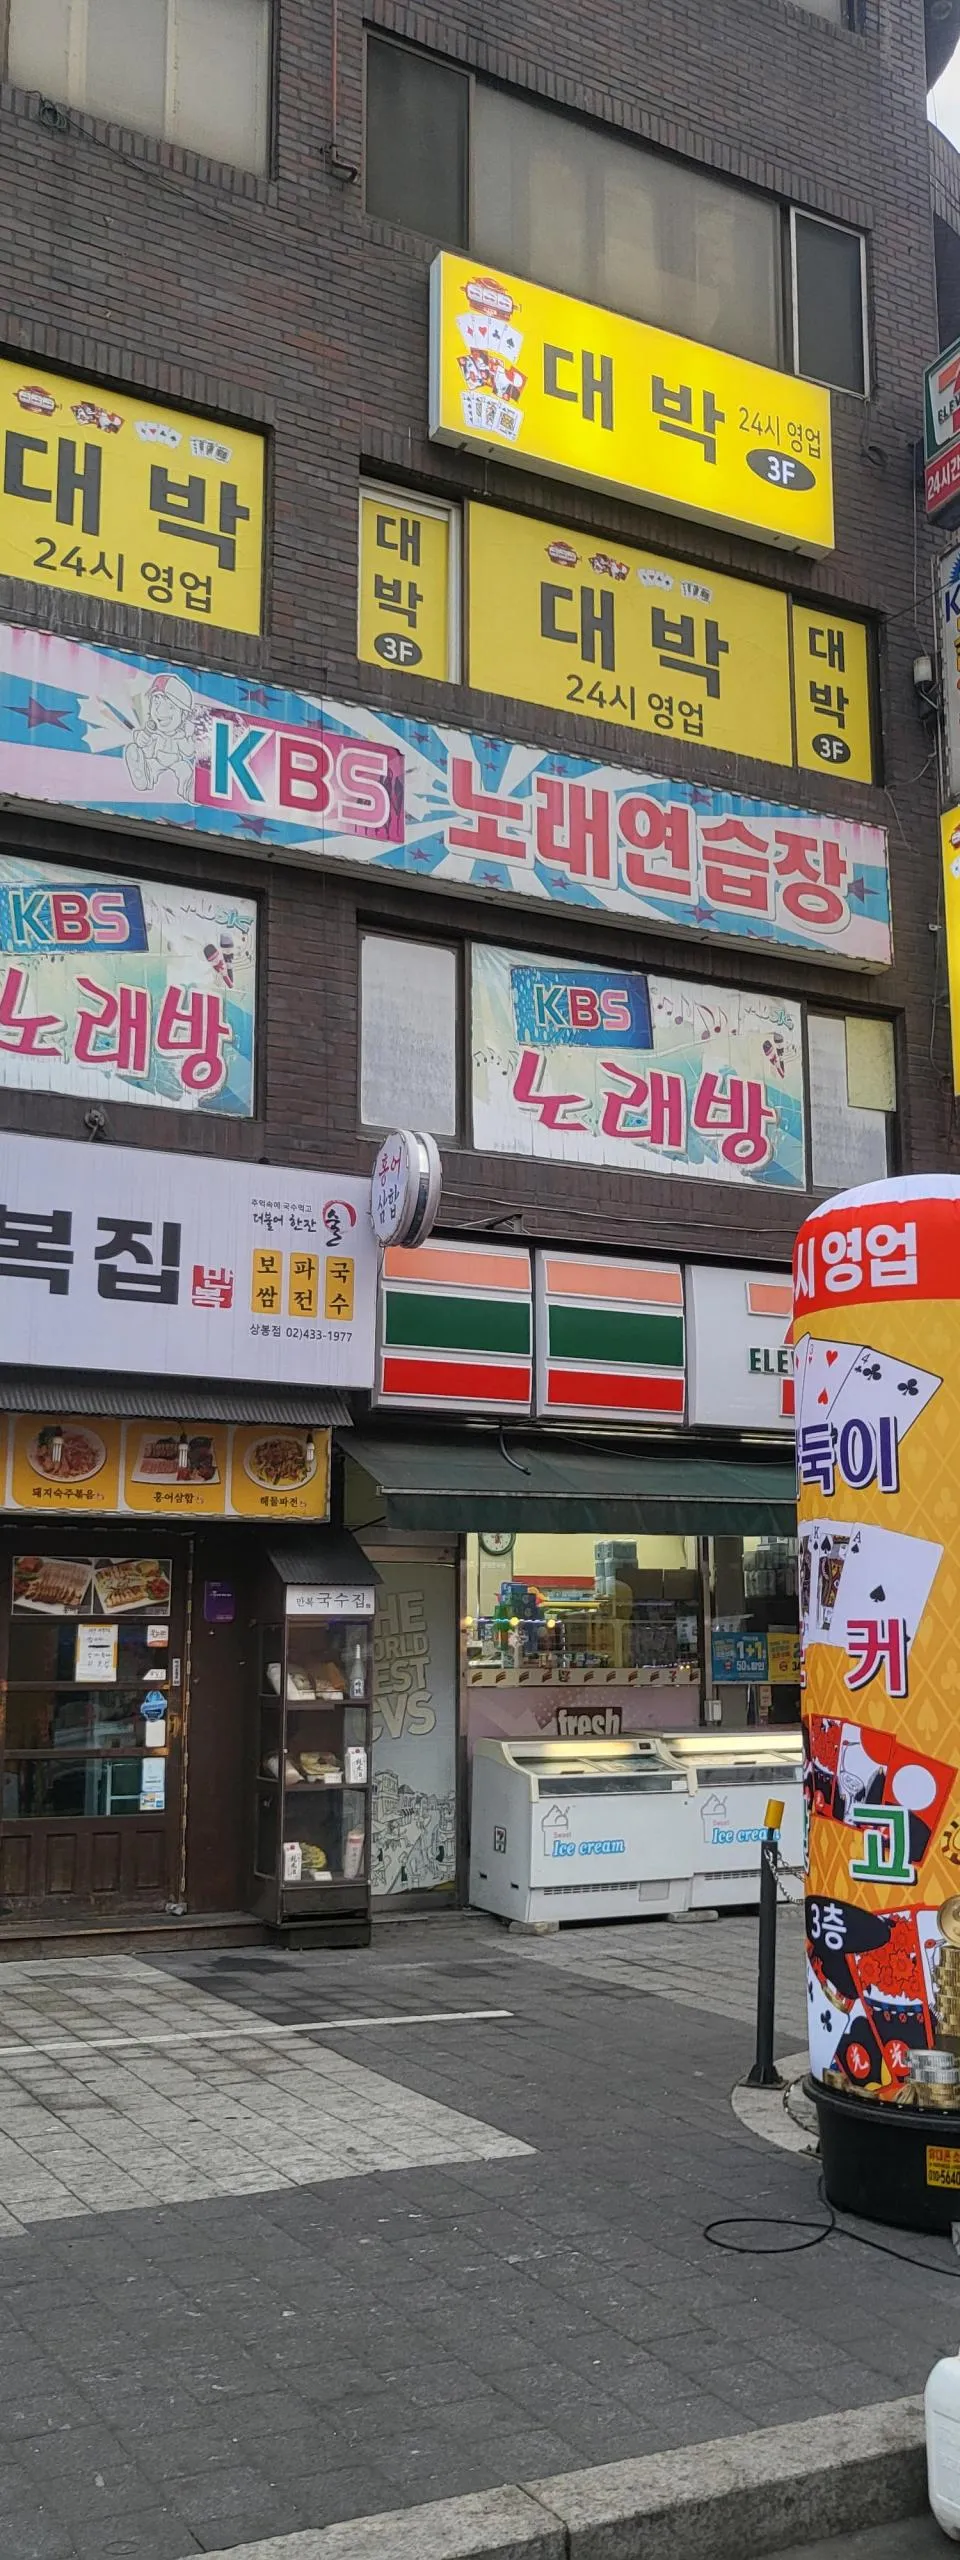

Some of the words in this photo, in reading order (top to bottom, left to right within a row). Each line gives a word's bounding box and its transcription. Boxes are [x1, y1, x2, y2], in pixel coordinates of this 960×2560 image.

[739, 407, 780, 446] 24시
[786, 423, 821, 459] 영업
[767, 456, 795, 484] 3F
[33, 537, 124, 592] 24시
[140, 562, 212, 614] 영업
[382, 636, 414, 663] 3F
[566, 674, 636, 721] 24시
[648, 692, 704, 738] 영업
[819, 738, 844, 763] 3F
[212, 719, 390, 828] KBS
[449, 757, 847, 925] 노래연습장
[10, 891, 129, 943] KBS
[0, 967, 230, 1089] 노래방
[535, 984, 631, 1031] KBS
[513, 1050, 772, 1164] 노래방
[253, 1212, 283, 1231] 더불어
[289, 1214, 316, 1232] 한잔
[821, 1221, 917, 1293] 영업
[256, 1256, 278, 1308] 보쌈
[294, 1257, 315, 1311] 파전
[329, 1263, 350, 1315] 국수
[250, 1324, 281, 1337] 상봉점
[286, 1328, 352, 1342] 02)433-1977
[750, 1348, 794, 1373] ELE
[153, 1492, 195, 1504] 홍어삼합
[737, 1641, 762, 1659] 1+1
[558, 1708, 620, 1736] fresh
[553, 1840, 575, 1856] Ice
[579, 1839, 625, 1855] cream
[712, 1828, 733, 1843] Ice
[811, 1903, 847, 1950] 3층
